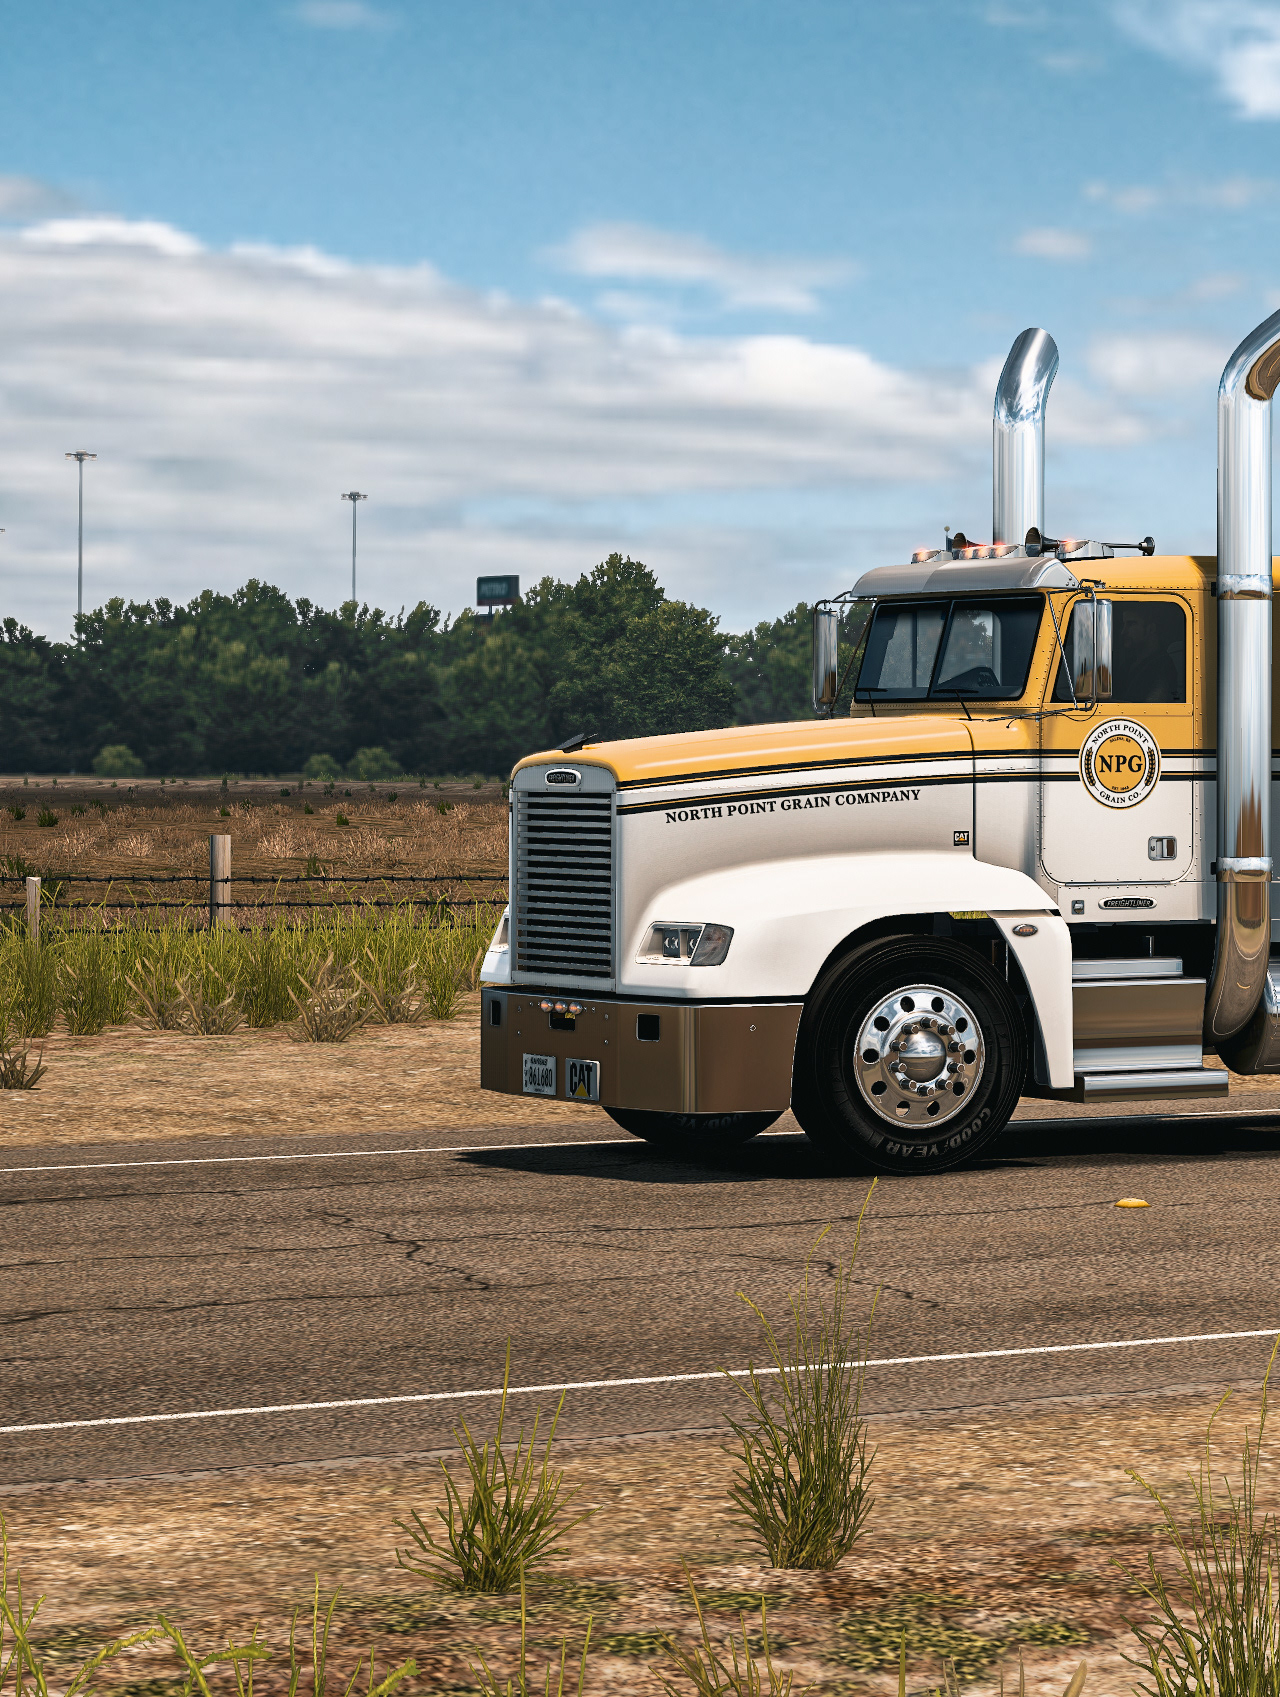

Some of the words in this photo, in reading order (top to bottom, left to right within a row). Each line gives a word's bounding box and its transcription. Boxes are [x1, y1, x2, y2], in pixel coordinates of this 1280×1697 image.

[1091, 724, 1120, 745] NORTH
[1123, 724, 1149, 744] POINT
[1099, 755, 1143, 773] NPG
[665, 806, 722, 823] NORTH
[727, 800, 777, 817] POINT
[780, 795, 831, 811] GRAIN
[834, 789, 921, 806] COMNPANY
[1099, 790, 1126, 804] GRAIN
[1128, 791, 1141, 802] CO.
[954, 832, 969, 841] CAT
[1106, 899, 1151, 907] FREIGHTLINER
[569, 1062, 592, 1097] CAT
